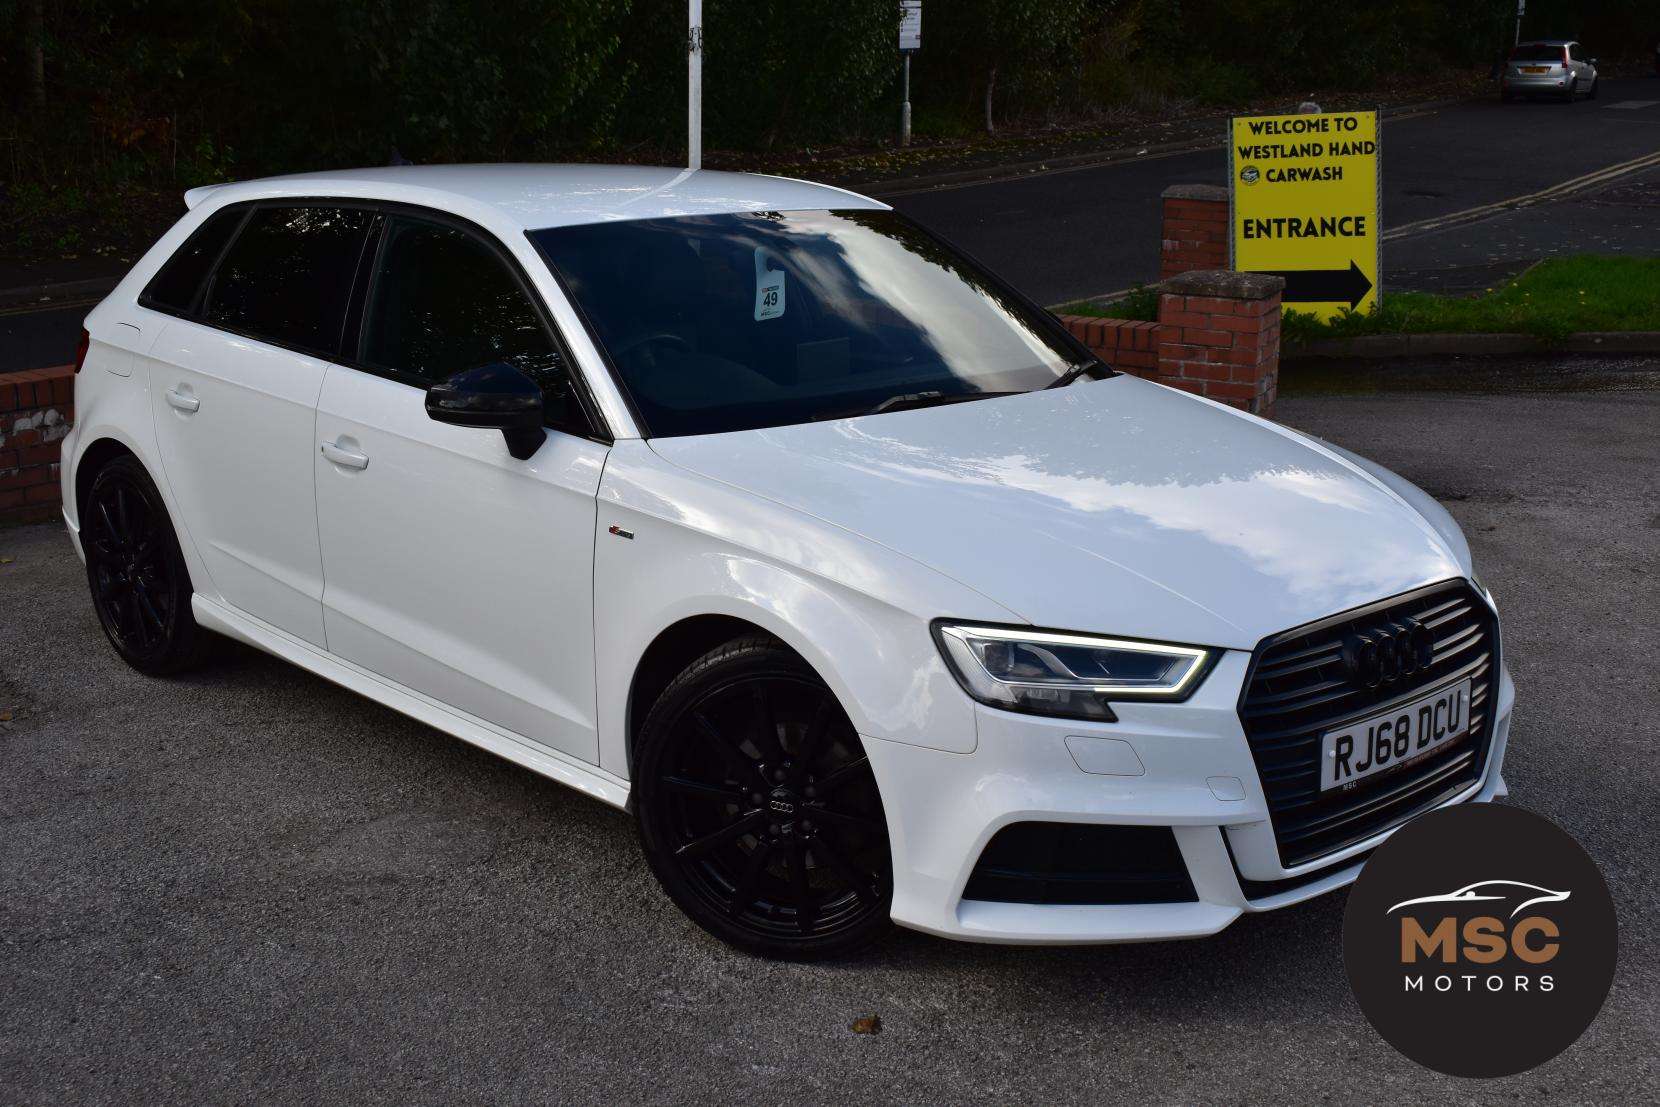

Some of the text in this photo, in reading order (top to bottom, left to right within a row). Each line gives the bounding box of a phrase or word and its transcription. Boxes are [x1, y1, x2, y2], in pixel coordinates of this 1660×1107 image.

[1249, 117, 1358, 135] WELCOME TO
[1238, 141, 1376, 160] WESTLAND HAND
[1266, 166, 1343, 182] CARWASH
[1243, 216, 1366, 239] ENTRANCE
[763, 291, 778, 307] 49
[1334, 714, 1410, 781] RJ68
[1417, 690, 1462, 750] DCU
